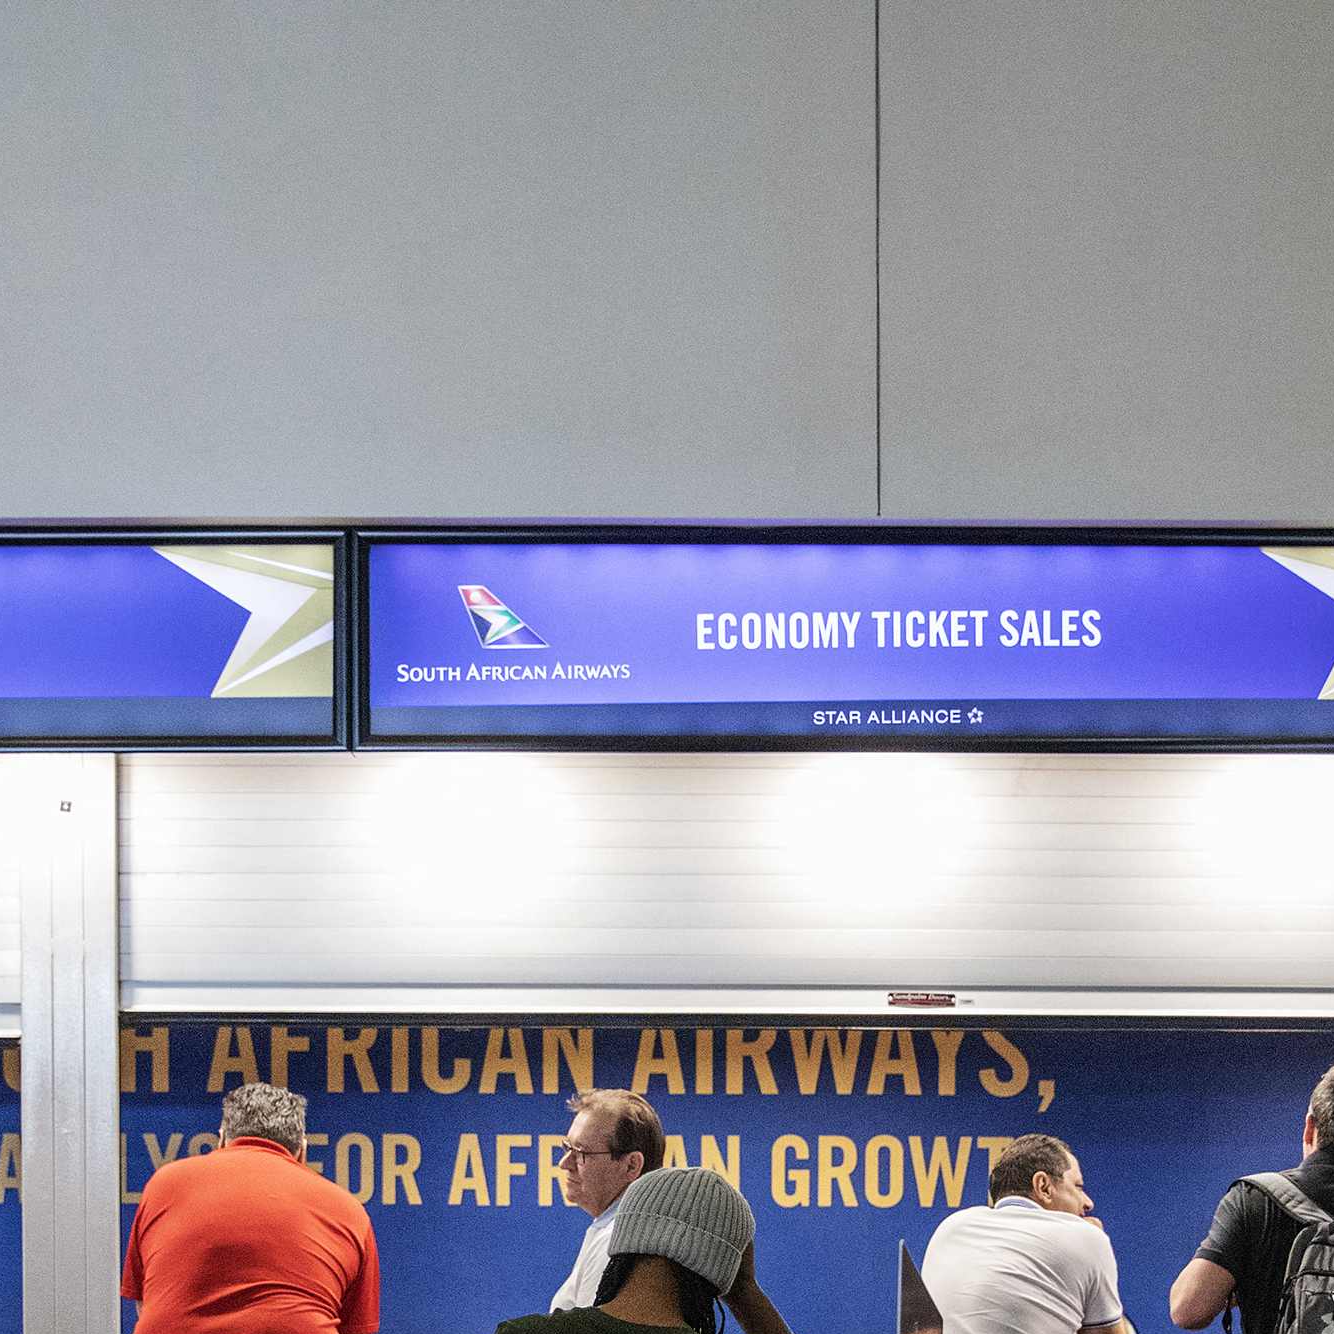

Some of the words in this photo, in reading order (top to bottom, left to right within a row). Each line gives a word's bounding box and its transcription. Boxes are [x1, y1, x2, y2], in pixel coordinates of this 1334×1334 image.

[696, 611, 861, 650] ECONOMY
[871, 610, 989, 648] TICKET
[999, 610, 1102, 647] SALES
[397, 664, 461, 682] SOUTH
[466, 663, 547, 682] AFRICAN
[551, 662, 631, 681] AIRWAYS
[813, 710, 862, 725] STAR
[866, 709, 961, 724] ALLIANCE
[770, 1133, 1015, 1209] GROWT
